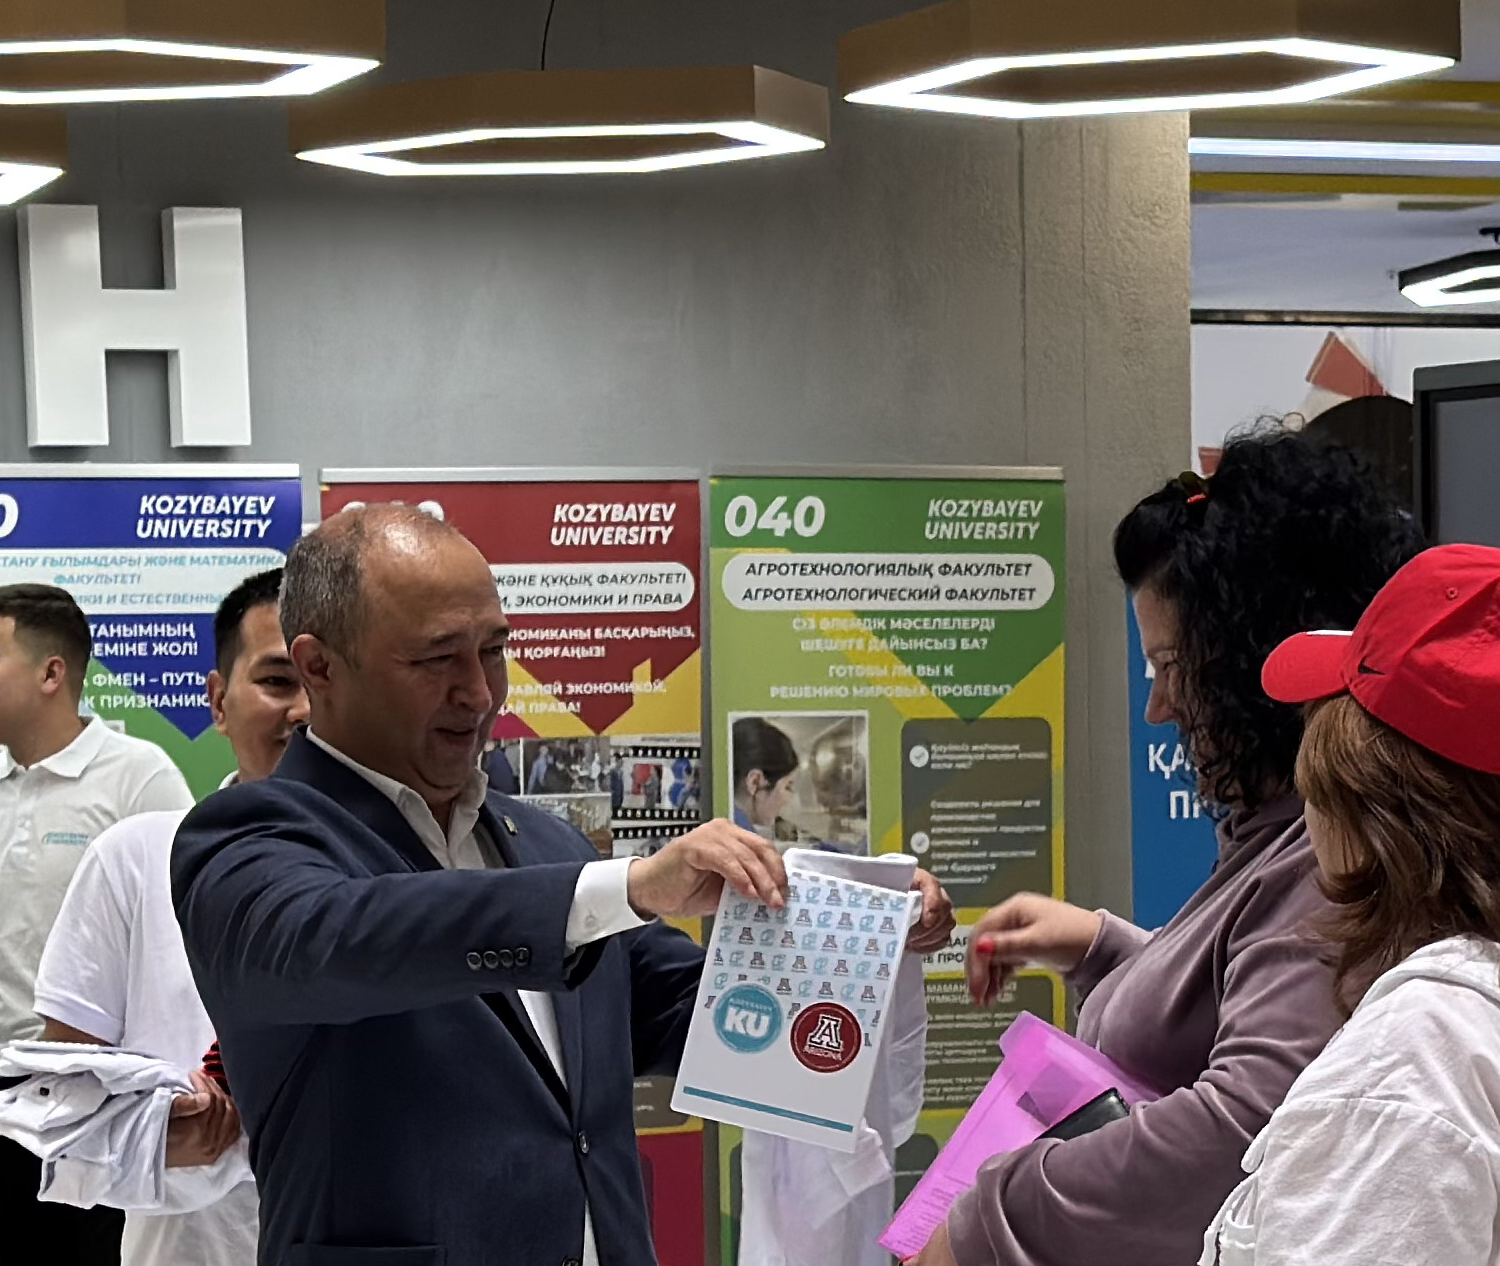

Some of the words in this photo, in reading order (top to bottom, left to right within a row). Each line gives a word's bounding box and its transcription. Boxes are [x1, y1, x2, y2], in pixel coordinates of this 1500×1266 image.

[140, 495, 275, 516] KOZYBAYEV
[553, 503, 676, 523] KOZYBAYEV
[928, 499, 1043, 519] KOZYBAYEV
[724, 495, 826, 537] 040
[136, 519, 271, 539] UNIVERSITY
[551, 525, 674, 546] UNIVERSITY
[924, 521, 1040, 540] UNIVERSITY
[598, 573, 686, 585] ФАКУЛЬТЕТІ
[745, 562, 934, 580] АГРОТЕХНОЛОГИЯЛЫҚ
[938, 562, 1032, 577] ФАКУЛЬТЕТ
[515, 595, 613, 607] ЭКОНОМИКИ
[618, 595, 629, 605] И
[633, 593, 683, 604] ПРАВА
[741, 585, 941, 601] АГРОТЕХНОЛОГИЧЕСКИЙ
[945, 586, 1036, 602] ФАКУЛЬТЕТ
[890, 617, 996, 632] МӘСЕЛЕЛЕРДІ
[153, 642, 198, 656] ЖОЛ!
[868, 636, 957, 652] ДАЙЫНСЫЗ
[961, 638, 988, 650] БА?
[93, 673, 145, 686] ФМЕН
[162, 672, 207, 686] ПУТЬ
[917, 665, 940, 677] ВЫ
[770, 685, 849, 698] РЕШЕНИЮ
[931, 685, 1012, 697] ПРОБЛЕМ?
[529, 701, 581, 713] ПРАВА!
[724, 1005, 770, 1038] KU
